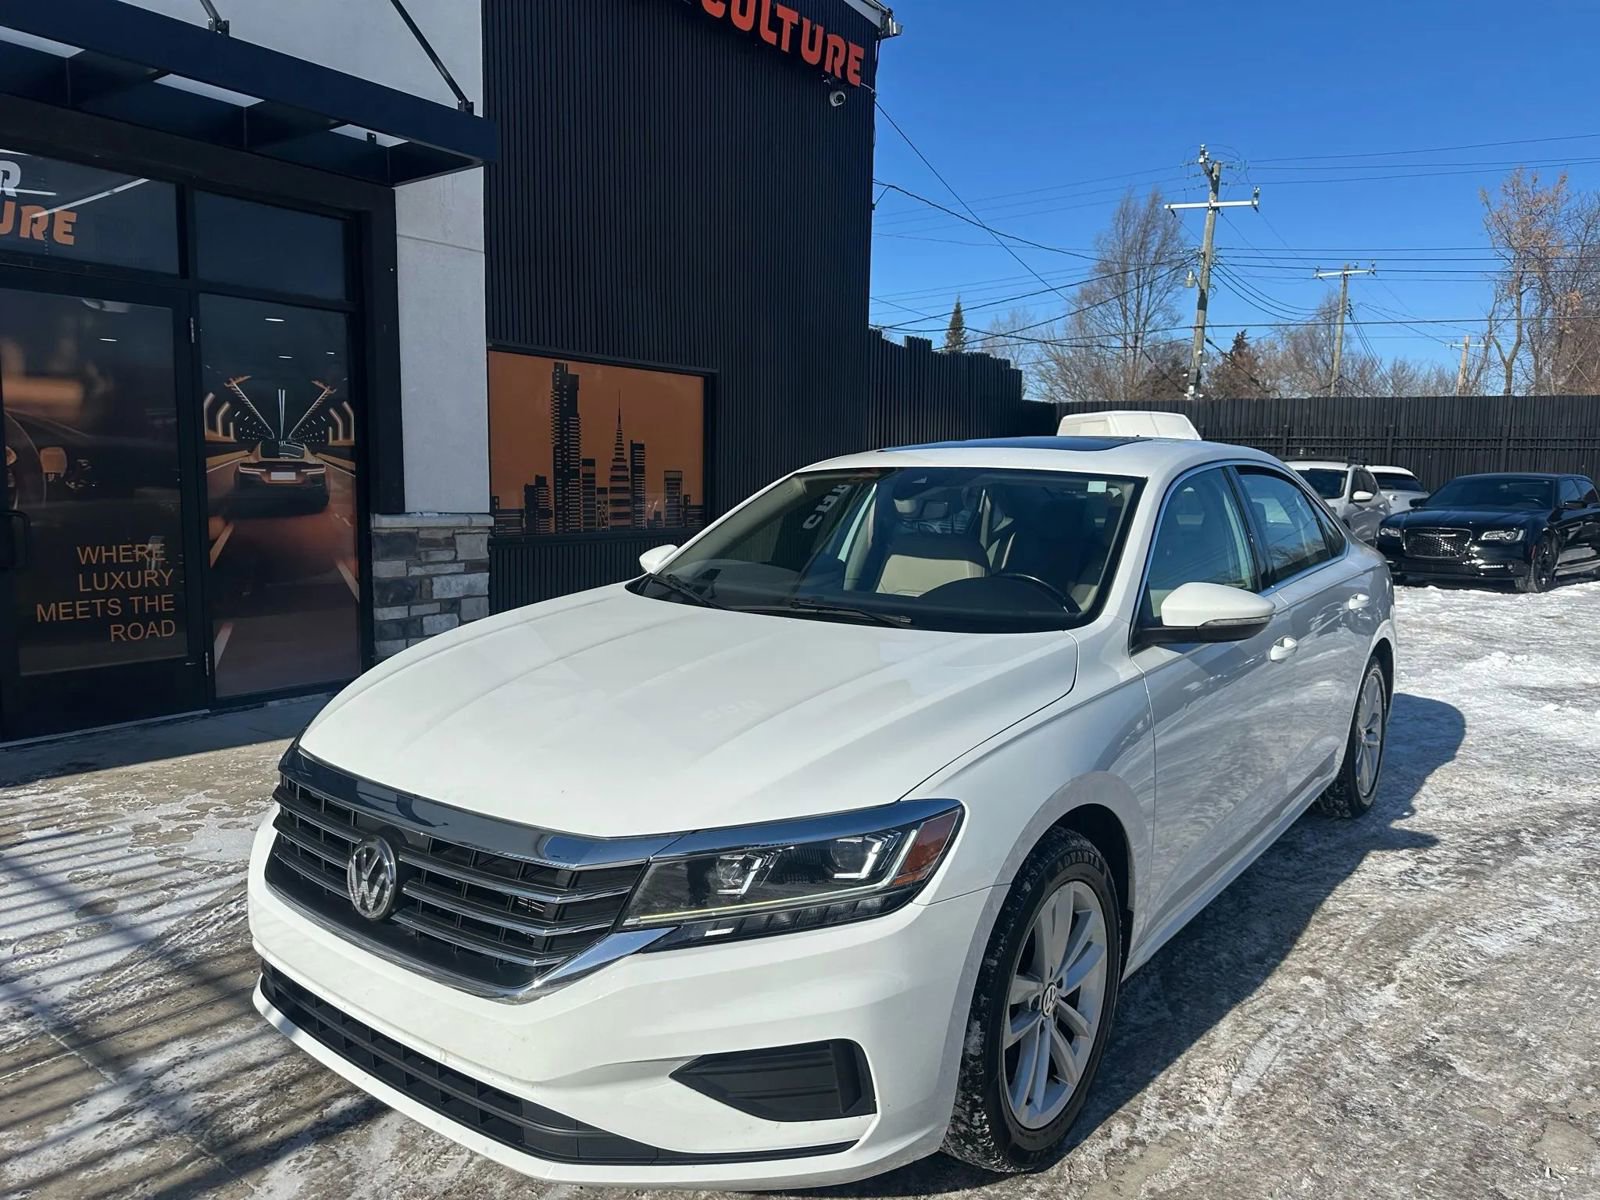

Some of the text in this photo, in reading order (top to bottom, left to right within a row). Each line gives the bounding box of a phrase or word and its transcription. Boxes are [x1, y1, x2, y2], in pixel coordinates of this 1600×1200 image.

[76, 543, 166, 565] WHERE
[78, 568, 174, 592] LUXURY
[36, 593, 176, 623] MEETS THE
[110, 619, 176, 643] ROAD
